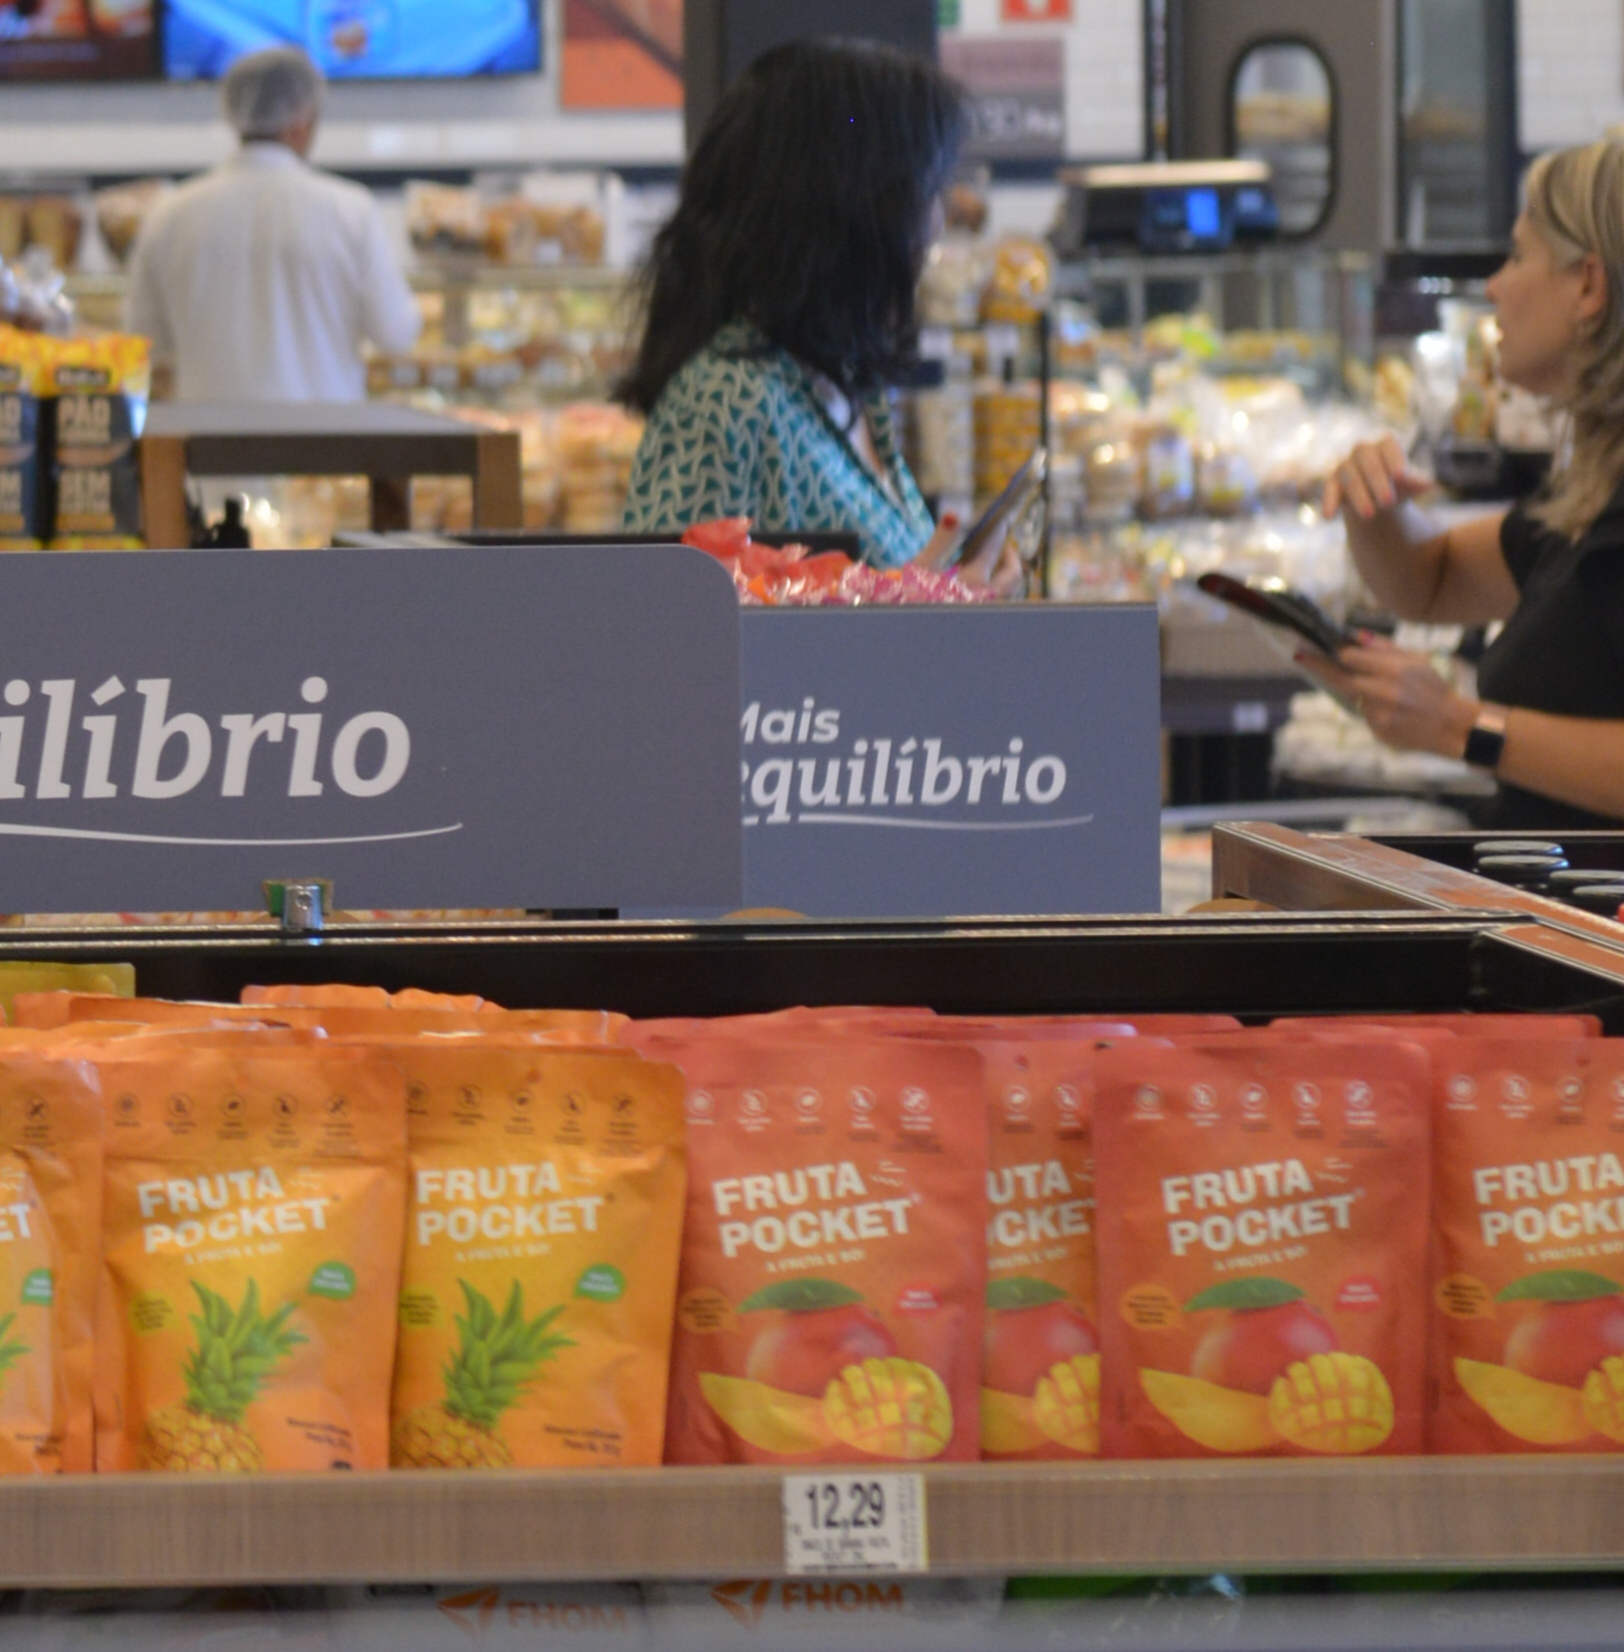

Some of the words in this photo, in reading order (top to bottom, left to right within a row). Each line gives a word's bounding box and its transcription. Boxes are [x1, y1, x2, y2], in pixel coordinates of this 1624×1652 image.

[137, 1165, 286, 1219] FRUTA
[415, 1160, 563, 1205] FRUTA
[711, 1160, 869, 1216] FRUTA
[988, 1160, 1073, 1205] UTA
[1161, 1158, 1314, 1214] FRUTA
[1472, 1152, 1624, 1205] FRUTA
[143, 1196, 332, 1255] POCKET
[415, 1194, 606, 1247] POCKET
[717, 1198, 915, 1259] POCKET
[989, 1199, 1096, 1248] CKE
[1167, 1194, 1356, 1257] POCKET
[1479, 1197, 1624, 1248] POCK
[806, 1482, 886, 1541] 12,29
[781, 1582, 904, 1614] FHOM
